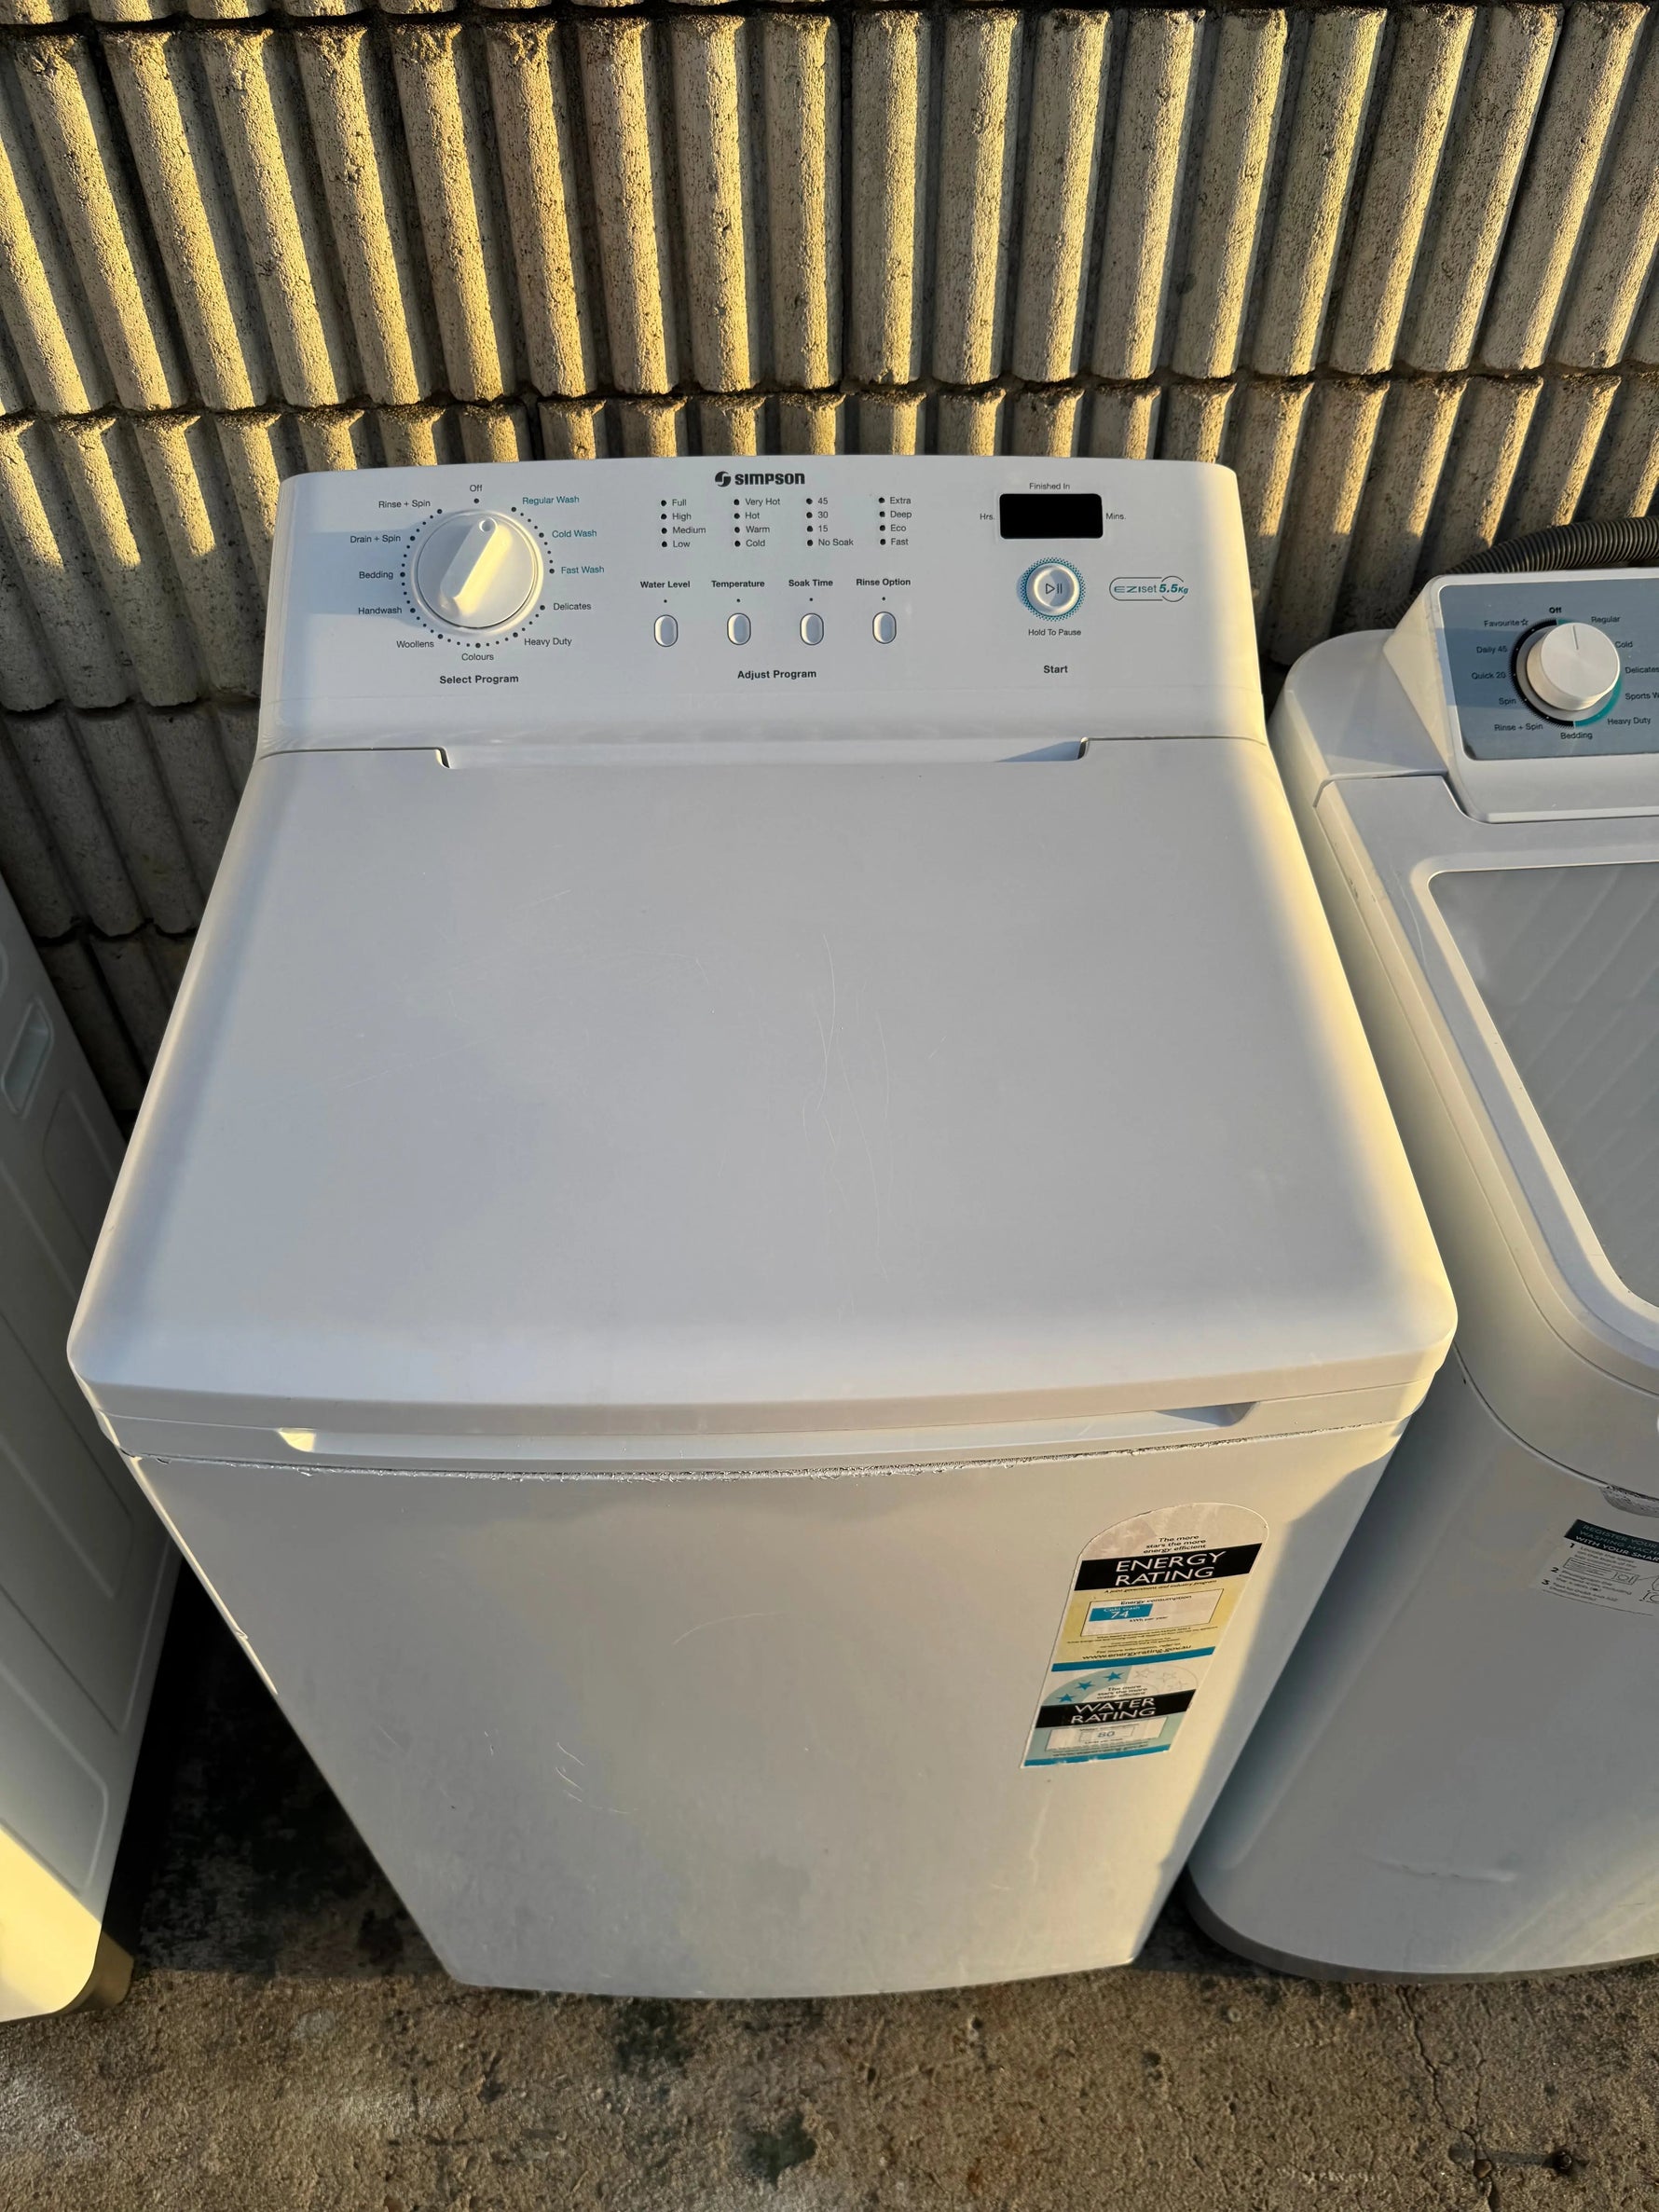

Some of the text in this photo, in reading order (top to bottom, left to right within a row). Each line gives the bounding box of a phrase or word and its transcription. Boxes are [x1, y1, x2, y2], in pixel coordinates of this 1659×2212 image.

[734, 473, 805, 486] SIMPSON
[469, 484, 483, 492] Off
[1029, 482, 1071, 490] Finished In
[412, 500, 431, 508] Spin
[522, 495, 580, 506] Regular Wash
[745, 497, 781, 507] Very Hot
[817, 497, 829, 505] 45
[672, 513, 692, 522] High
[745, 512, 760, 520] Hot
[817, 511, 829, 519] 30
[890, 511, 912, 520] Deep
[552, 529, 597, 538] Cold Wash
[672, 526, 706, 534] Medium
[350, 535, 373, 543] Drain
[381, 534, 401, 544] Spin
[746, 539, 765, 547] Cold
[832, 538, 854, 546] Soak
[890, 538, 909, 546] Fast
[673, 540, 691, 548] Low
[561, 565, 605, 574] Fast Wash
[359, 570, 393, 580] Bedding
[639, 580, 691, 589] Water Level
[711, 580, 765, 589] Temperature
[788, 579, 833, 587] Soak Time
[856, 578, 911, 588] Rinse Option
[358, 607, 403, 615] Handwash
[553, 602, 592, 611] Delicates
[1591, 615, 1621, 624] Regular
[524, 638, 572, 648] Heavy Duty
[1476, 646, 1496, 654] Daily
[461, 653, 494, 662] Colours
[1043, 665, 1068, 674] Start
[737, 669, 816, 680] Adjust Program
[439, 674, 519, 685] Select Program
[1499, 697, 1516, 706] Spin
[1625, 693, 1651, 701] Sports
[1607, 717, 1651, 726] Heavy Duty
[1526, 723, 1542, 732] Spin
[1560, 732, 1593, 740] Bedding
[1580, 1530, 1625, 1548] WASHING
[1582, 1524, 1658, 1549] REGISTER YOUR
[1575, 1535, 1600, 1547] WITH
[1602, 1544, 1629, 1555] YOUR
[1116, 1550, 1227, 1573] ENERGY
[1115, 1566, 1215, 1587] RATING
[1146, 1595, 1192, 1603] consumption
[1111, 1610, 1130, 1619] 74
[1082, 1644, 1192, 1660] www.energyrating.gov.au
[1074, 1697, 1155, 1714] WATER
[1071, 1707, 1157, 1724] RATING
